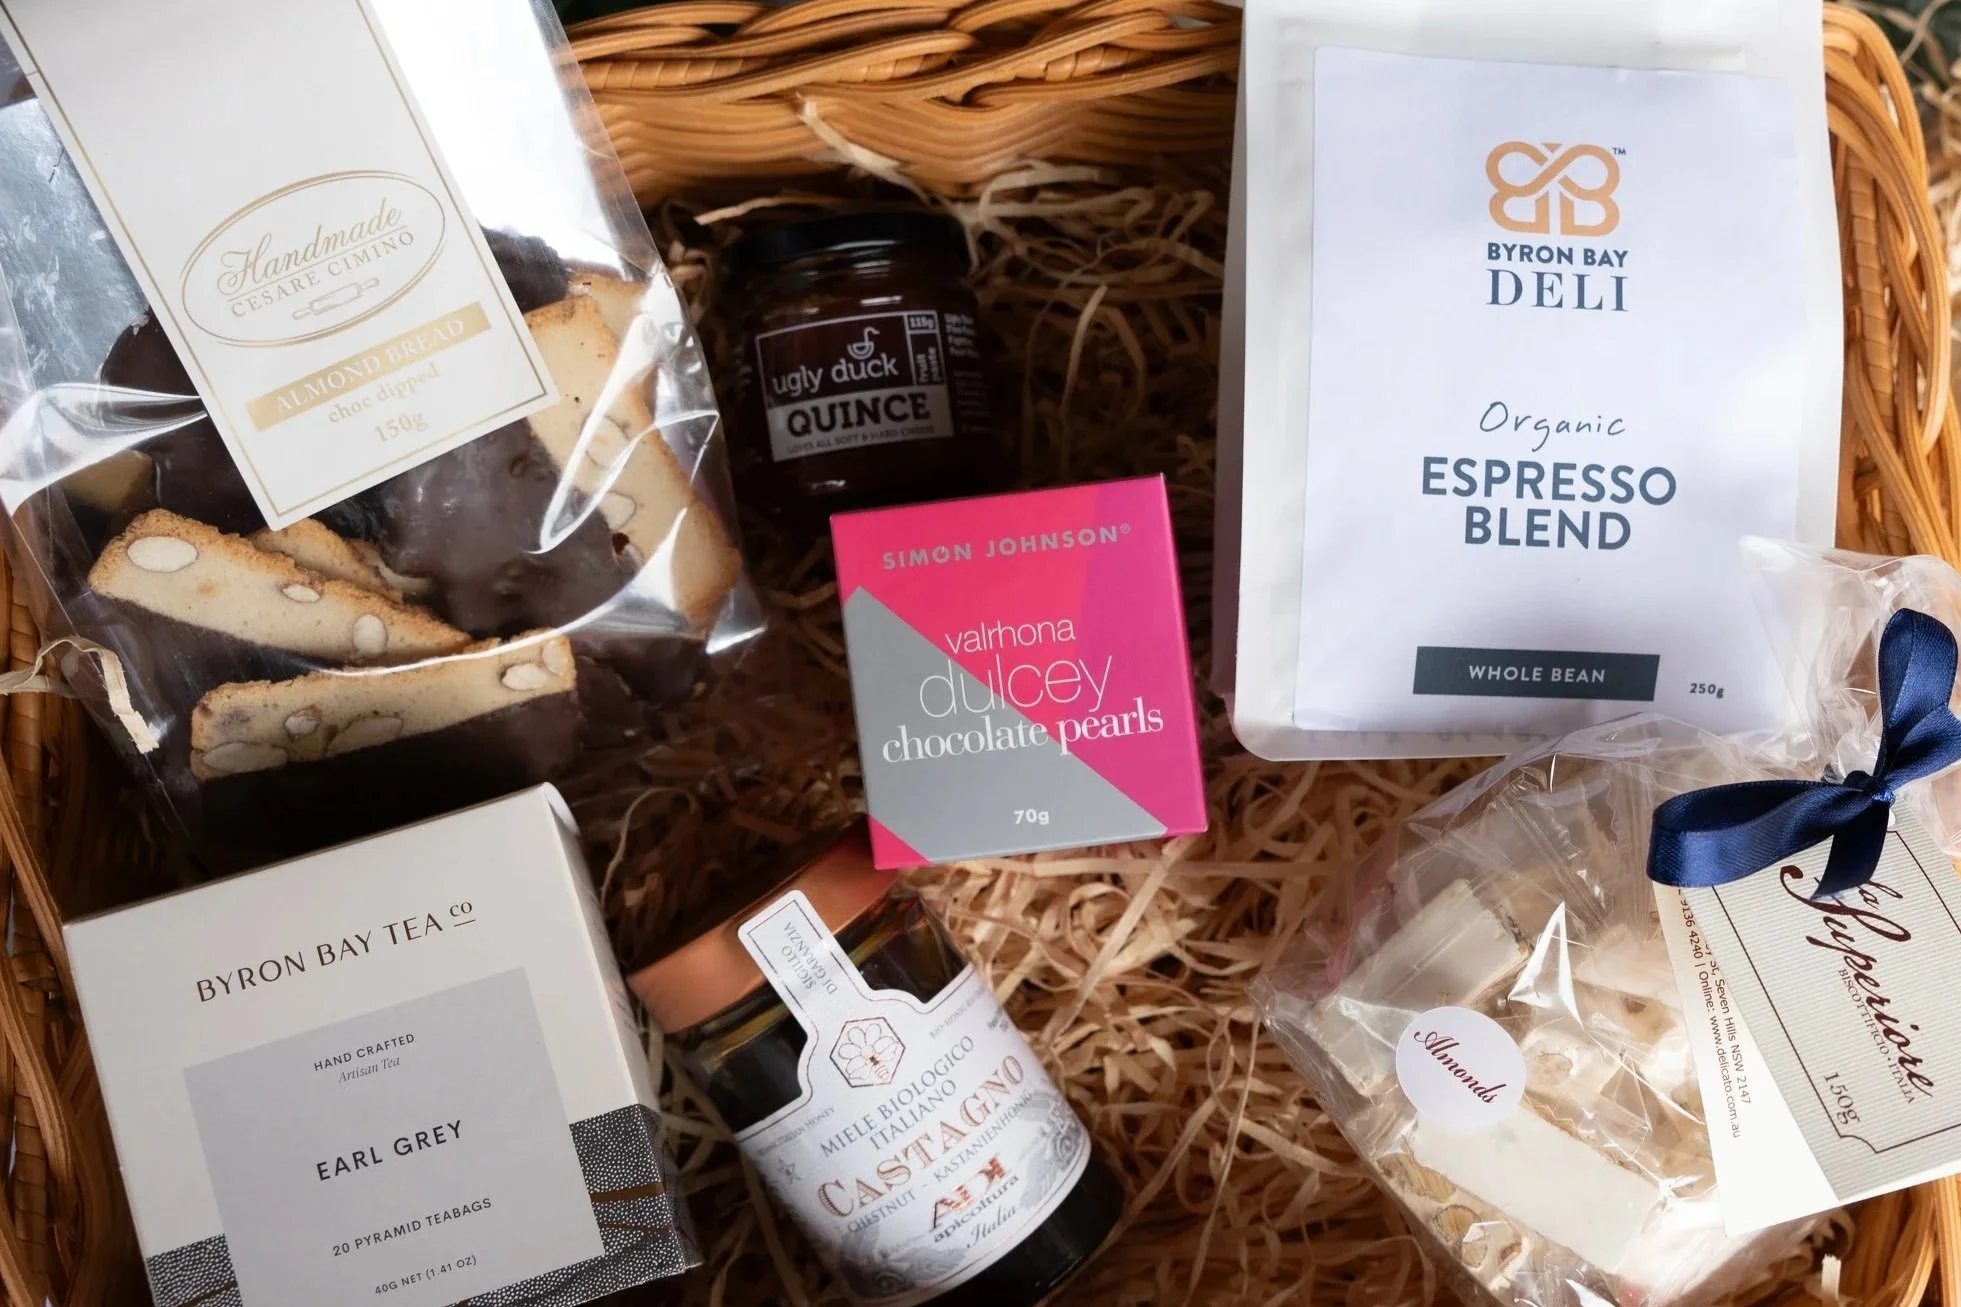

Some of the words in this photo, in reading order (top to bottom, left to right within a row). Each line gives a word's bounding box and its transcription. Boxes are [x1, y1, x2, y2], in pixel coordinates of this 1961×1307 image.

[216, 196, 402, 295] Handmade
[1487, 242, 1574, 266] BYRON
[1583, 248, 1629, 268] BAY
[231, 270, 320, 317] CESARE
[327, 230, 414, 276] CIMINO
[1486, 268, 1629, 312] DELI
[276, 354, 381, 414] ALMOND
[384, 317, 465, 364] BREAD
[772, 365, 823, 397] ugly
[830, 353, 899, 383] duck
[327, 403, 373, 423] choc
[375, 361, 440, 401] dipped
[787, 392, 931, 438] QUINCE
[373, 410, 428, 443] 150g
[1479, 401, 1627, 452] Organic
[1422, 456, 1677, 506] ESPRESSO
[1464, 505, 1631, 550] BLEND
[882, 543, 972, 570] SIMON
[945, 618, 1076, 654] valrhona
[919, 653, 1112, 718] dulcey
[1469, 664, 1543, 682] WHOLE
[1551, 668, 1606, 684] BEAN
[1689, 683, 1725, 699] 250g
[882, 715, 1048, 764] chocolate
[1056, 696, 1164, 756] pearls
[1013, 808, 1050, 825] 70g
[196, 951, 306, 1003] BYRON
[316, 930, 373, 967] BAY
[382, 912, 443, 945] TEA
[781, 945, 817, 990] SIGILLO
[783, 921, 827, 984] GARANZIA
[825, 983, 838, 996] DI
[1715, 979, 1730, 1014] Seven
[314, 1052, 352, 1071] HAND
[356, 1033, 415, 1059] CRAFTED
[1689, 930, 1704, 959] 4240
[1699, 971, 1715, 1012] Online:
[1710, 1015, 1741, 1138] www.delicato.com.au
[1724, 1017, 1737, 1042] Hills
[338, 1063, 379, 1084] Artisan
[381, 1056, 401, 1071] Tea
[1413, 1031, 1507, 1104] Almonds
[1730, 1044, 1744, 1072] NSW
[819, 1113, 879, 1158] MIELE
[877, 1036, 974, 1121] BIOLOGICO
[1737, 1076, 1751, 1104] 2147
[1823, 1071, 1860, 1125] 150g
[818, 1055, 1025, 1218] CASTAGNO
[869, 1079, 957, 1151] ITALIANO
[316, 1146, 383, 1181] EARL
[393, 1120, 461, 1156] GREY
[332, 1243, 350, 1257] 20
[354, 1220, 422, 1250] PYRAMID
[425, 1198, 492, 1227] TEABAGS
[847, 1188, 916, 1234] CHESTNUT
[934, 1173, 1019, 1243] apicoltura
[966, 1205, 1018, 1249] Italia
[374, 1283, 398, 1295] 40G
[401, 1272, 423, 1287] NET
[425, 1263, 452, 1281] (1.41
[456, 1255, 477, 1268] OZ)
